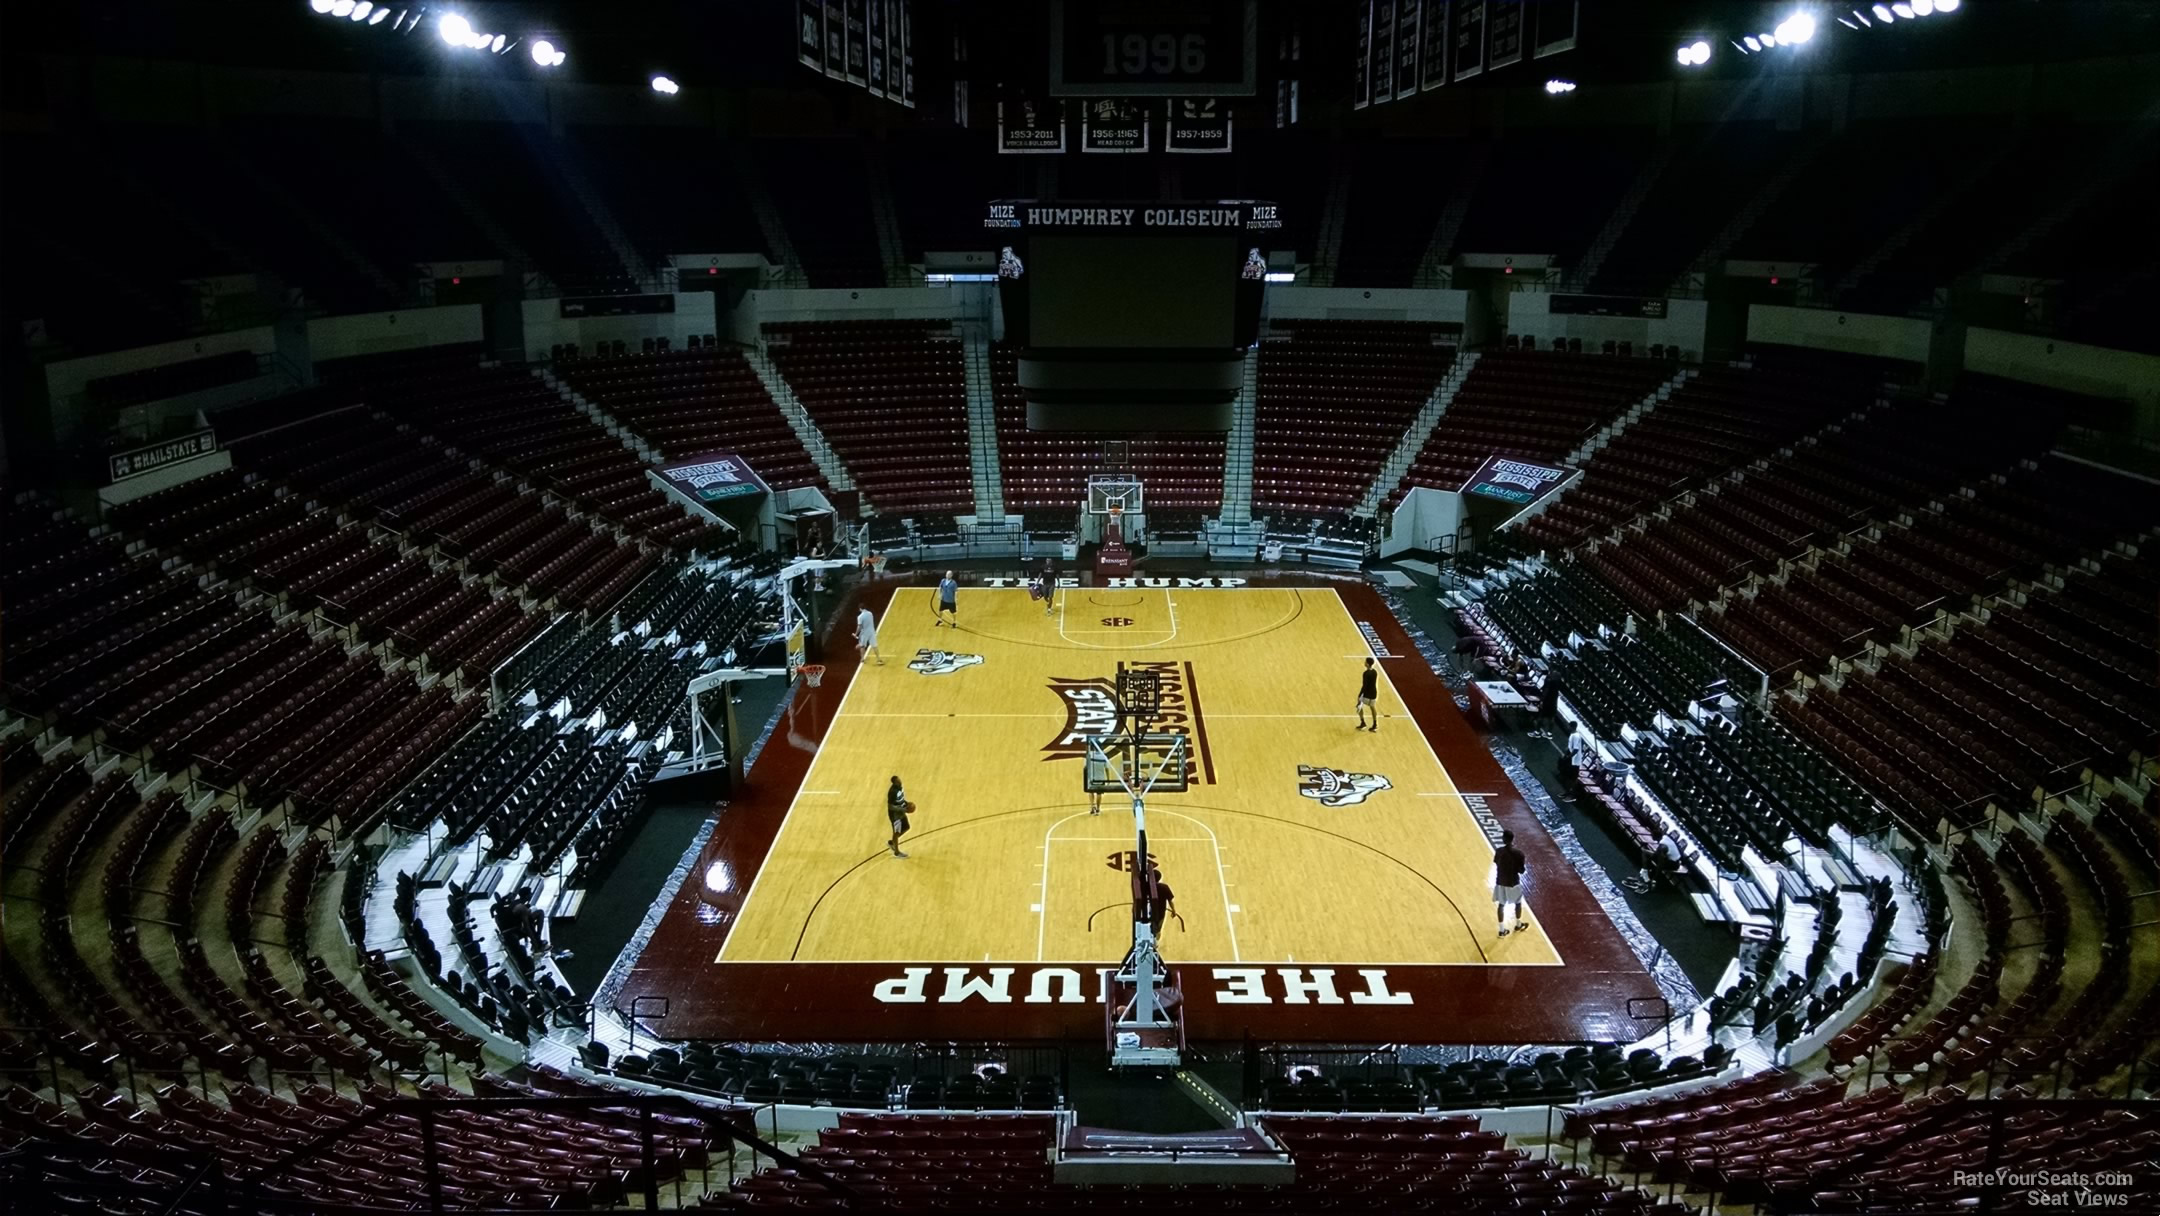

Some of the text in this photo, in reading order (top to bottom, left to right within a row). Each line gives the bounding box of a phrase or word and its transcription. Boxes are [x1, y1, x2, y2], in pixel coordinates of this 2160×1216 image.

[1102, 32, 1207, 75] 1996
[1010, 130, 1053, 139] 1953-2011
[1092, 129, 1139, 139] 1956-1965
[1176, 129, 1222, 139] 1957-1959
[990, 205, 1015, 218] MIZE
[1028, 209, 1240, 226] HUMPHREY COLISEUM
[1253, 206, 1277, 220] MIZE
[984, 219, 1022, 228] FOUNDATION
[1246, 220, 1283, 230] FOUNDATION
[132, 439, 198, 470] #HAILSTATE
[665, 461, 737, 480] MISSISSIPPI
[1493, 460, 1564, 480] MISSISSIPPI
[1107, 577, 1248, 588] HUMP
[1101, 617, 1135, 627] SEC
[873, 966, 1414, 1005] THE UMP
